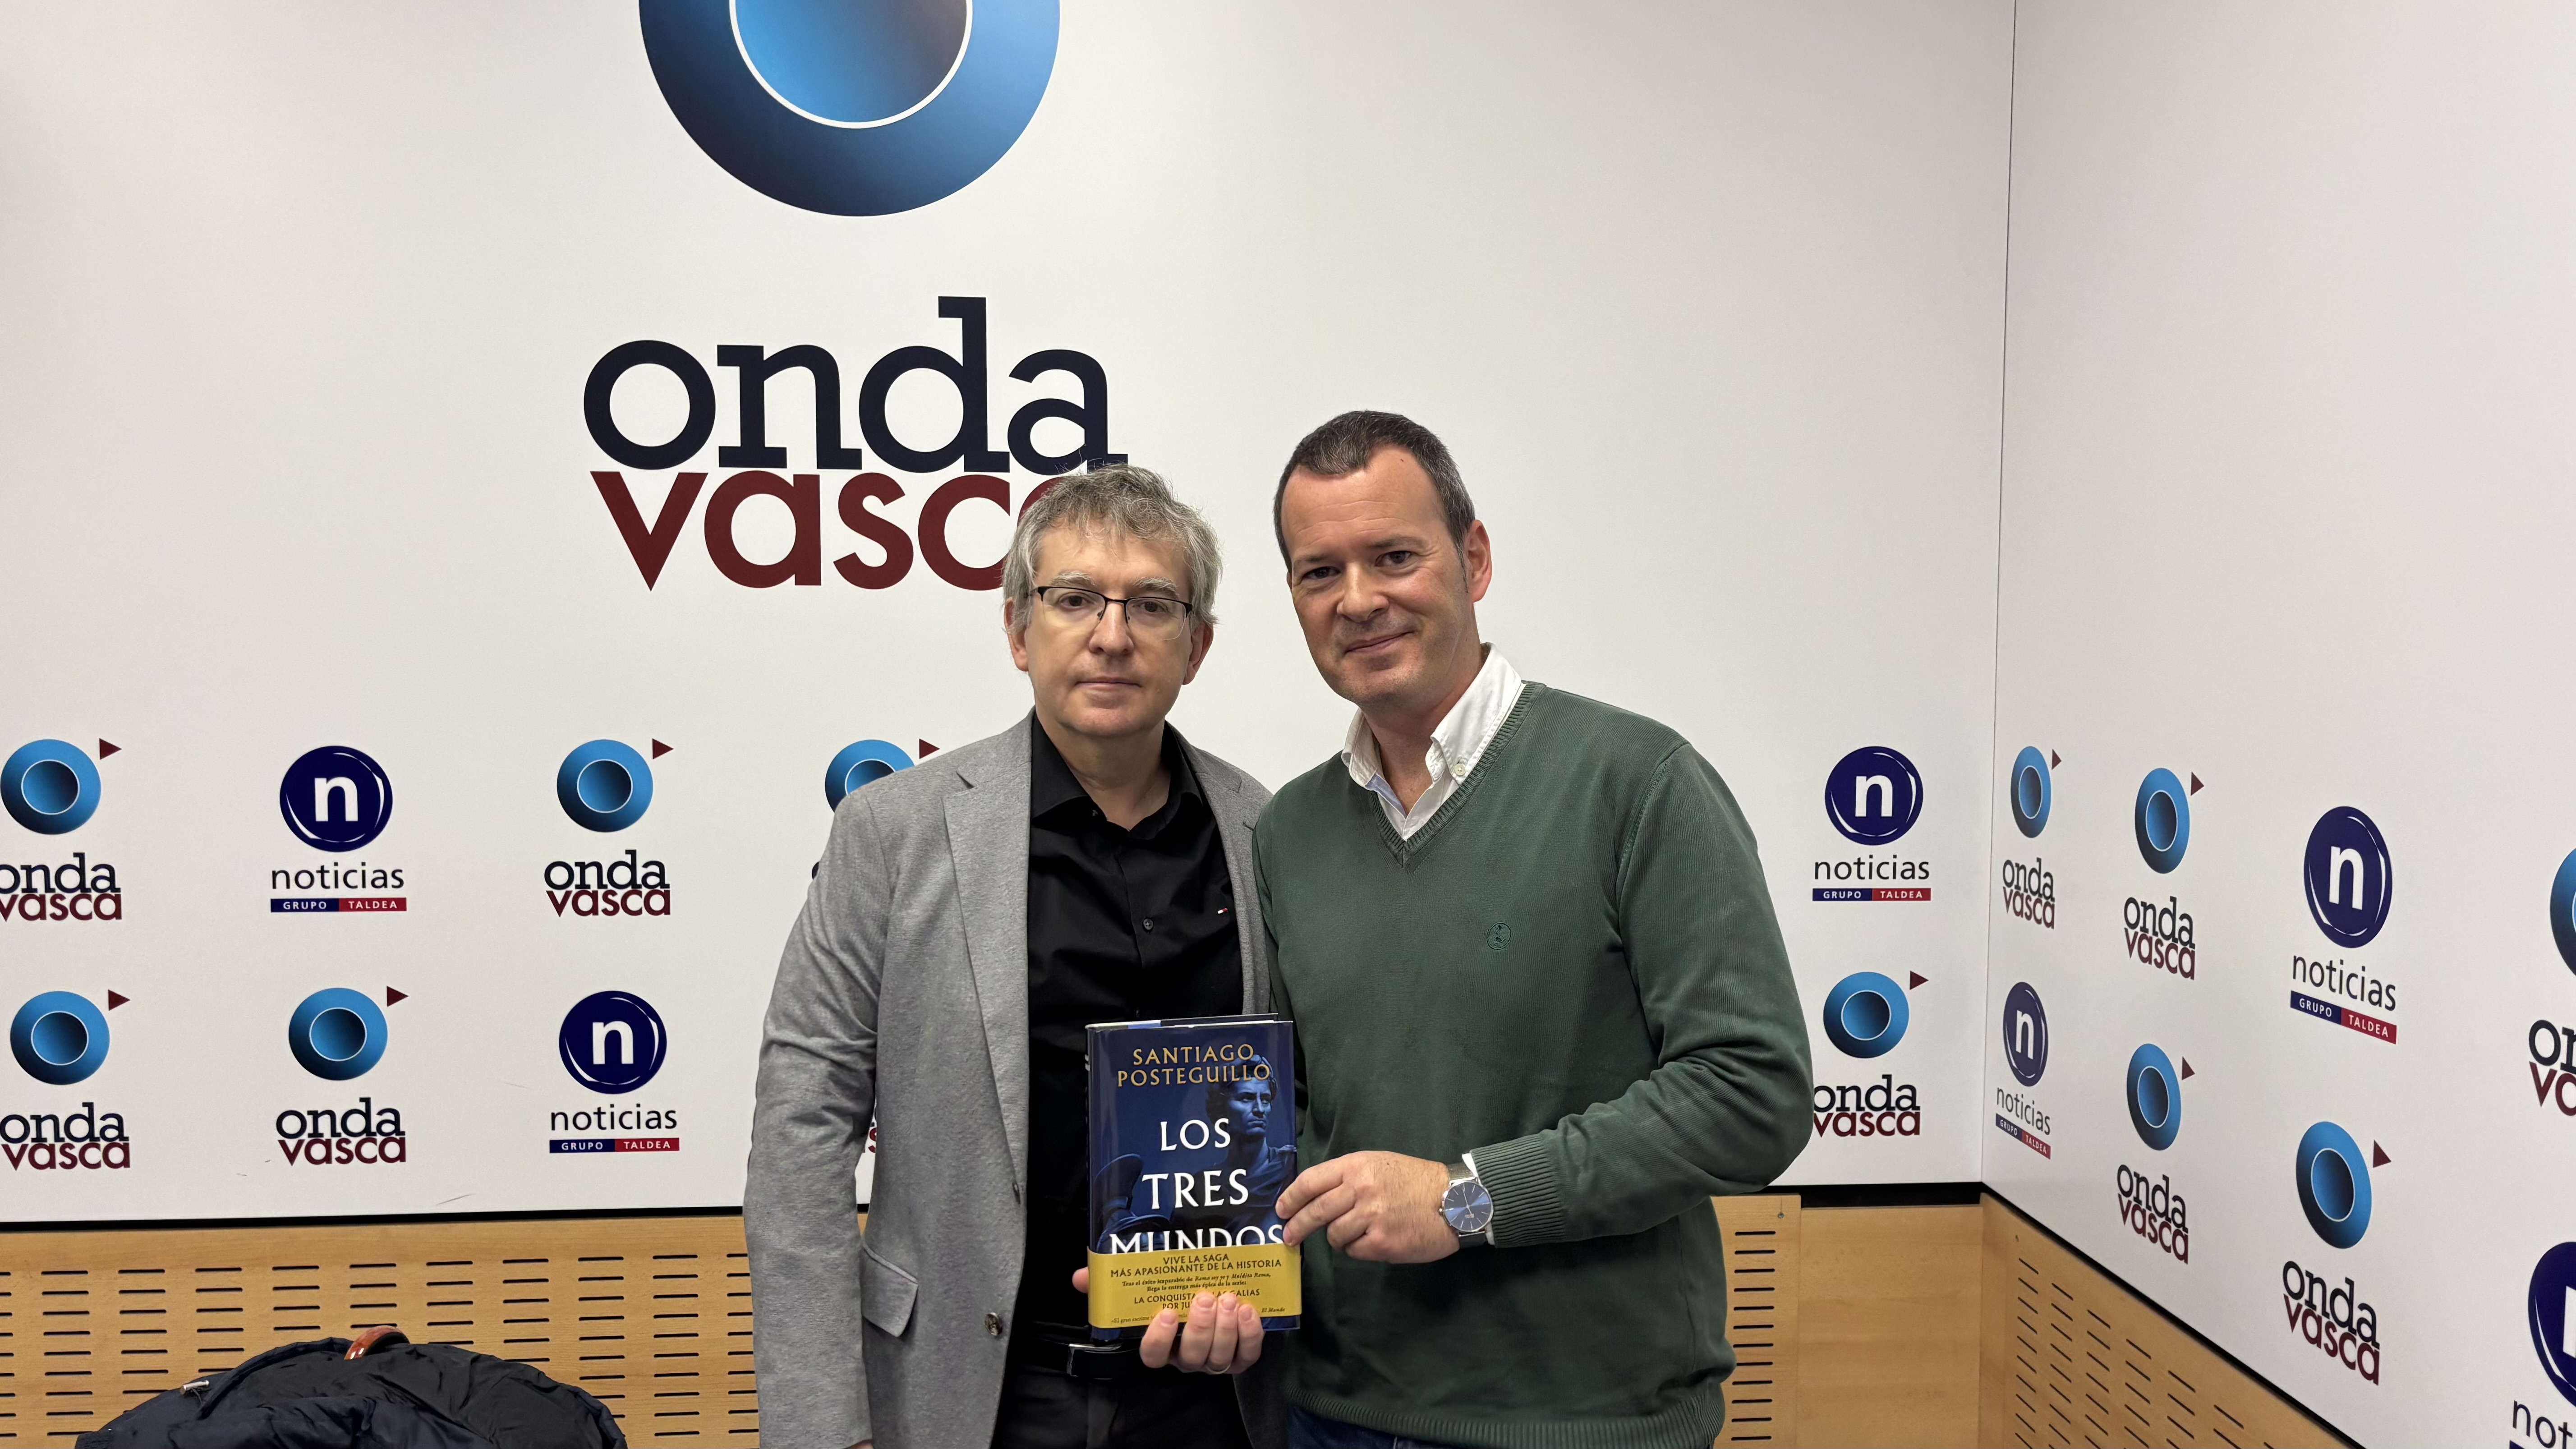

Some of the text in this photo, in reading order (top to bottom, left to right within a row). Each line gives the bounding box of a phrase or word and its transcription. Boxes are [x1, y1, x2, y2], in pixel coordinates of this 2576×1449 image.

[584, 296, 1128, 474] onda
[590, 470, 1062, 592] vasc
[314, 776, 359, 822] n
[1854, 774, 1893, 817] n
[271, 862, 404, 889] noticias
[544, 849, 670, 890] onda
[1815, 855, 1930, 880] noticias
[2002, 857, 2054, 902] onda
[2329, 846, 2364, 910] n
[283, 901, 398, 910] GRUPO TALDEA
[546, 889, 671, 917] vasca
[1823, 891, 1923, 899] GRUPO TALDEA
[2002, 886, 2055, 929] vasca
[2124, 896, 2195, 948] onda
[2124, 927, 2195, 980] vasca
[2292, 955, 2396, 1012] noticias
[2016, 1009, 2033, 1059] n
[2300, 998, 2388, 1038] GRUPO TALDEA
[592, 1020, 634, 1065] n
[1133, 1044, 1254, 1066] SANTIAGO
[1118, 1064, 1270, 1087] POSTEGUILLO
[1814, 1074, 1920, 1113] onda
[0, 1102, 129, 1143] onda
[276, 1097, 405, 1139] onda
[551, 1104, 677, 1131] noticias
[1814, 1110, 1920, 1138] vasca
[1996, 1086, 2051, 1136] noticias
[278, 1136, 405, 1166] vasca
[561, 1141, 671, 1151] GRUPO TALDEA
[1160, 1118, 1231, 1151] LOS
[2000, 1118, 2047, 1155] GRUPO TALDEA
[1, 1141, 130, 1171] vasca
[1141, 1168, 1249, 1210] TRES
[2117, 1164, 2189, 1233] onda
[2117, 1192, 2189, 1265] vasca
[1111, 1267, 1132, 1278] MÁS
[1134, 1263, 1204, 1276] APASIONANTE
[1237, 1259, 1282, 1269] HISTORIA
[1163, 1253, 1229, 1265] VIVE LA SAGA
[1147, 1293, 1195, 1303] CONQUISTA
[2283, 1261, 2380, 1349] onda
[2283, 1293, 2380, 1386] vasca
